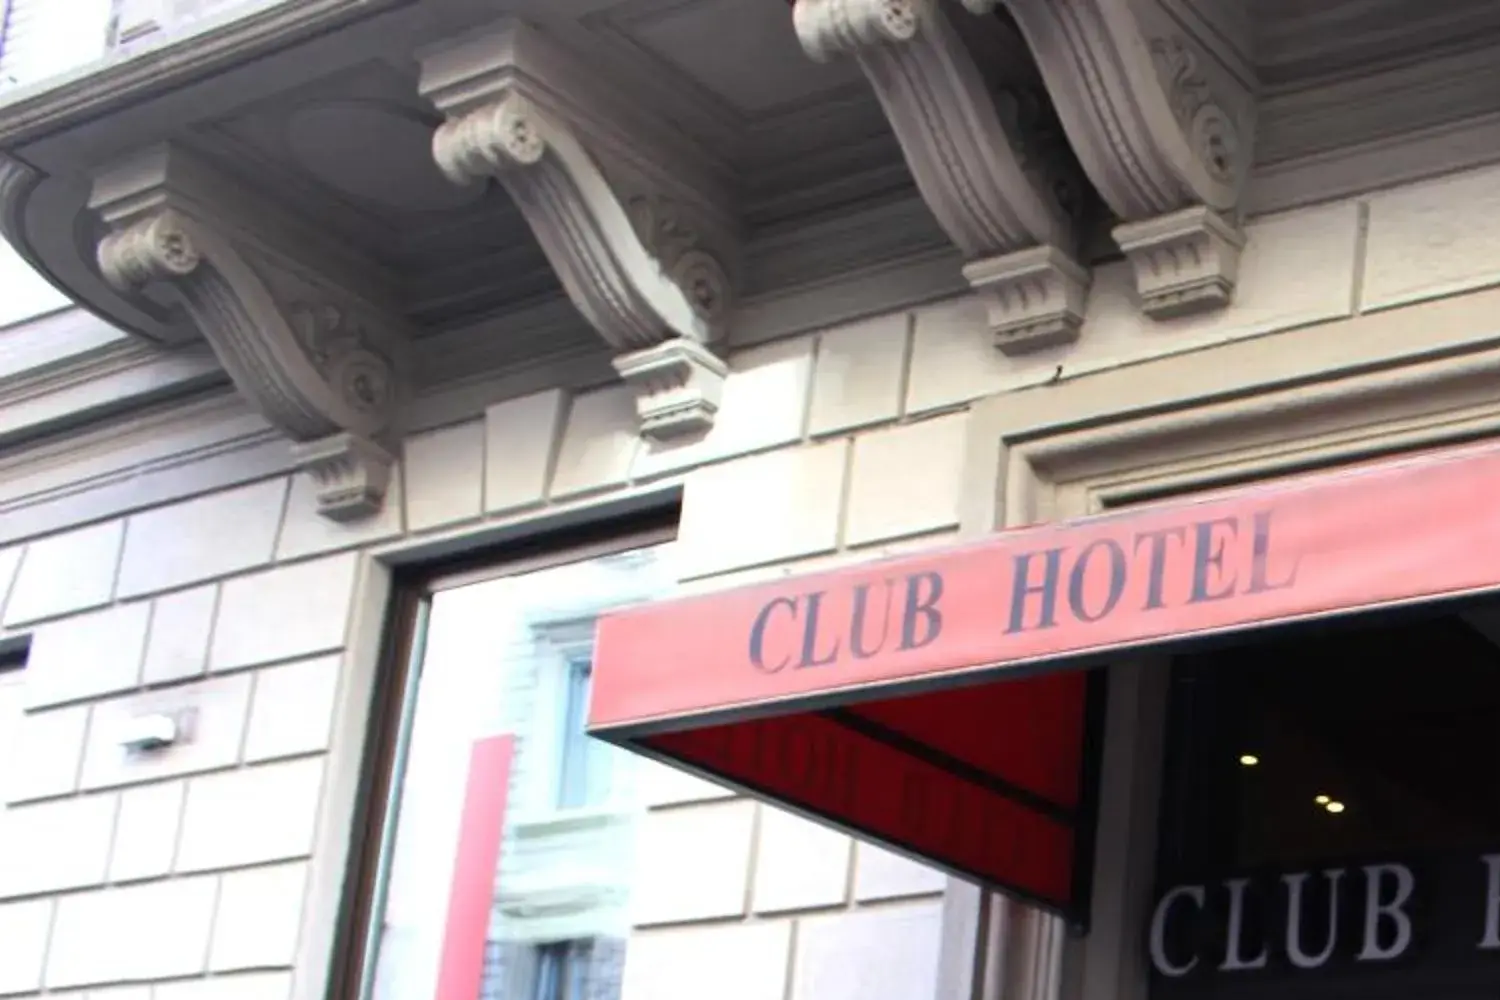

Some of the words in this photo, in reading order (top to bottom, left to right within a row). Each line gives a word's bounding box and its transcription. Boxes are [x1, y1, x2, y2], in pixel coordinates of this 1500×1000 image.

[747, 570, 944, 676] CLUB
[1002, 509, 1298, 635] HOTEL
[1149, 864, 1413, 977] CLUB
